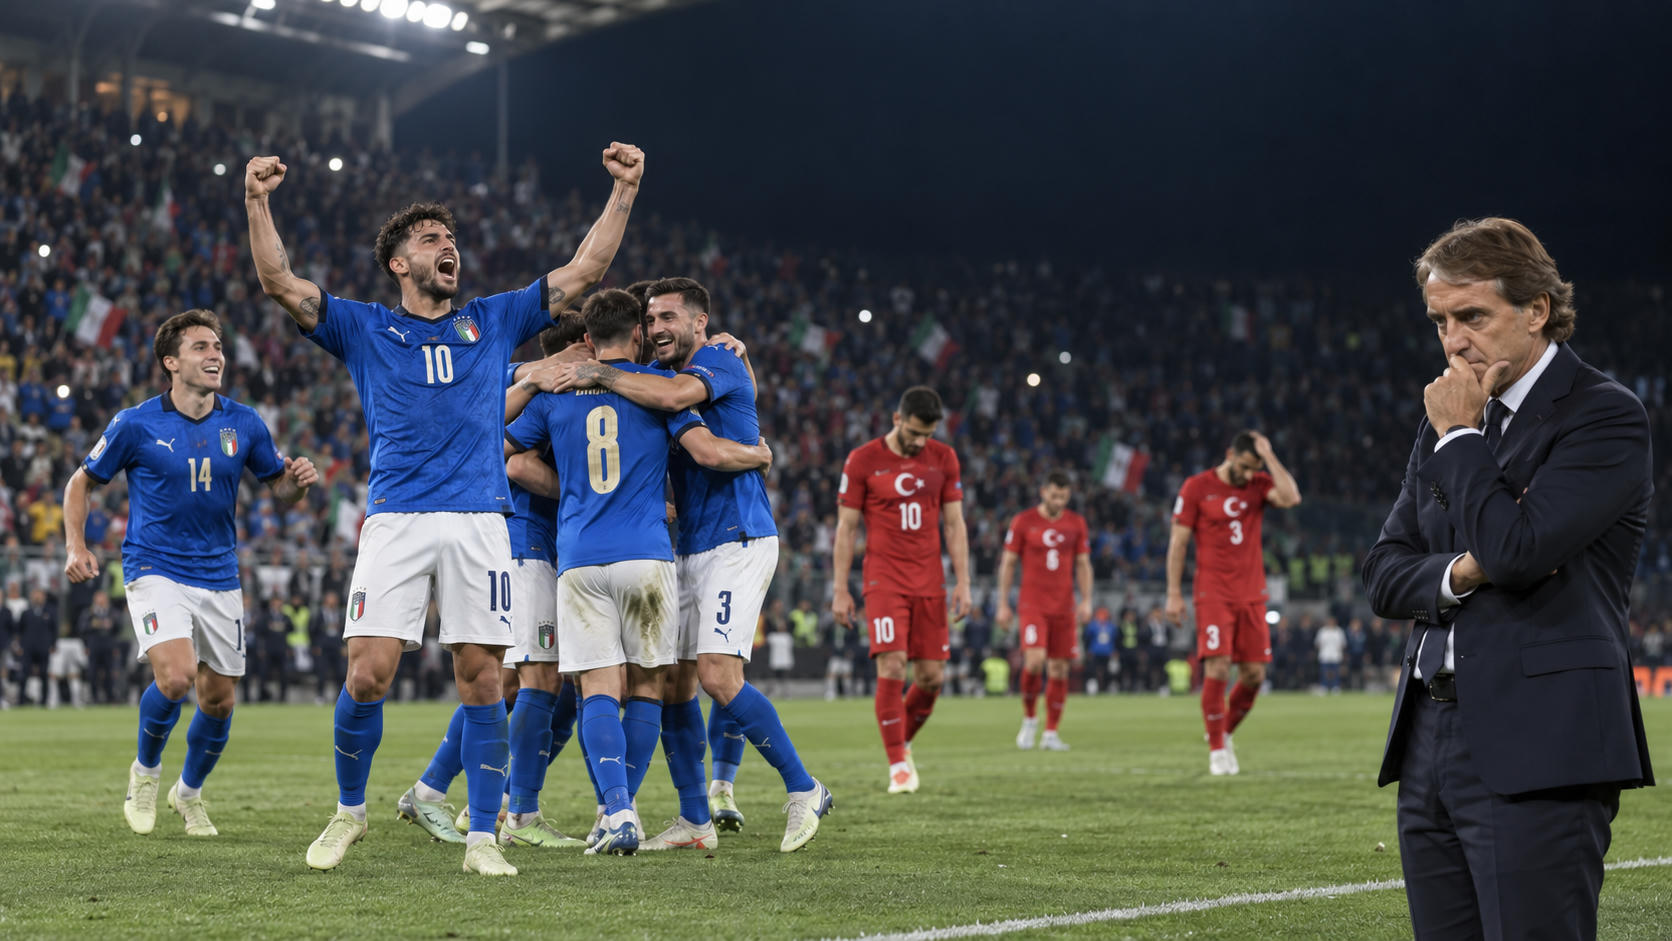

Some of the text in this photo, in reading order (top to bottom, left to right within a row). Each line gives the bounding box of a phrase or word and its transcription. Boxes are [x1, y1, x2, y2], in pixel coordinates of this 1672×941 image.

[422, 344, 454, 384] 10
[586, 405, 621, 495] 8
[187, 457, 212, 492] 14
[899, 502, 922, 531] 10
[1229, 519, 1244, 545] 3
[488, 570, 513, 612] 10
[716, 591, 732, 626] 3
[873, 616, 895, 645] 10
[1206, 624, 1220, 651] 3
